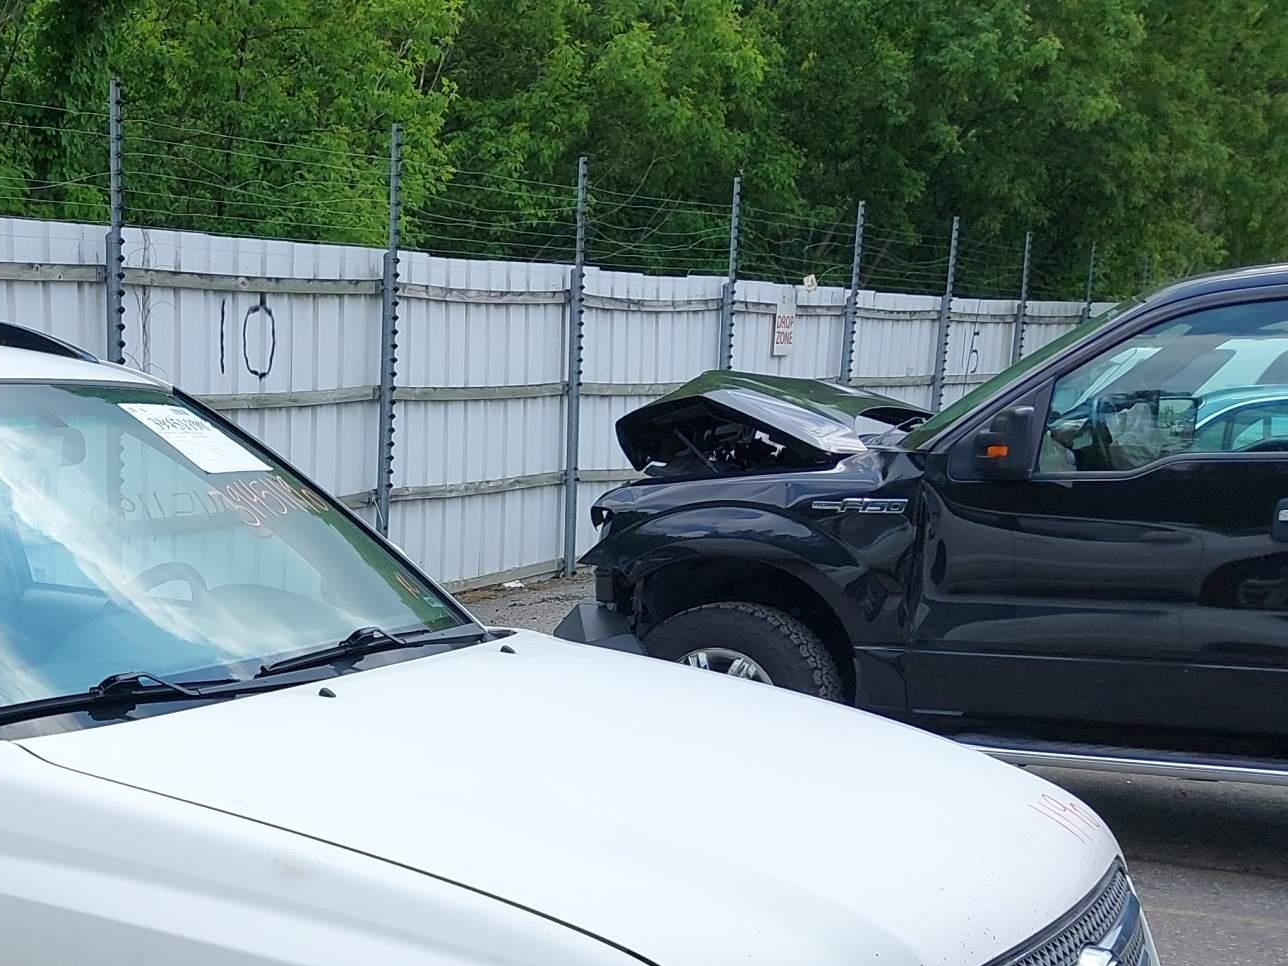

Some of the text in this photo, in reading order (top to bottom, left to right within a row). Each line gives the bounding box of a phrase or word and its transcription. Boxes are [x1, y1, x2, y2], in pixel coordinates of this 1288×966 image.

[777, 315, 795, 329] DROP
[220, 299, 275, 381] 10
[775, 331, 794, 345] ZONE
